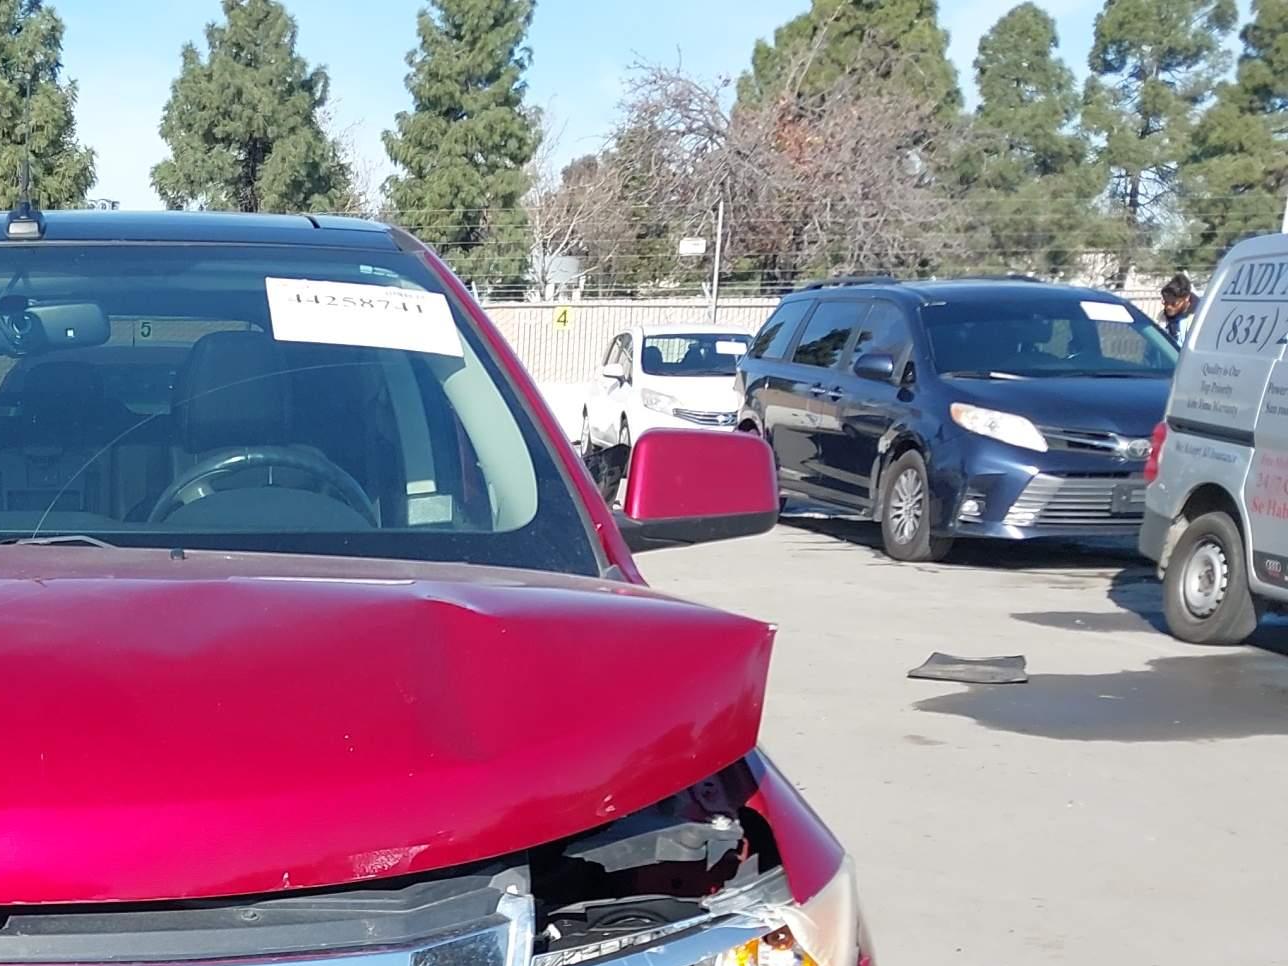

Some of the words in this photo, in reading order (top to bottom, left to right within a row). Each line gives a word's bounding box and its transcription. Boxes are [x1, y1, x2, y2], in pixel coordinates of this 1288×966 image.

[556, 309, 569, 327] 4
[140, 321, 153, 338] 5
[1215, 305, 1280, 353] (831)
